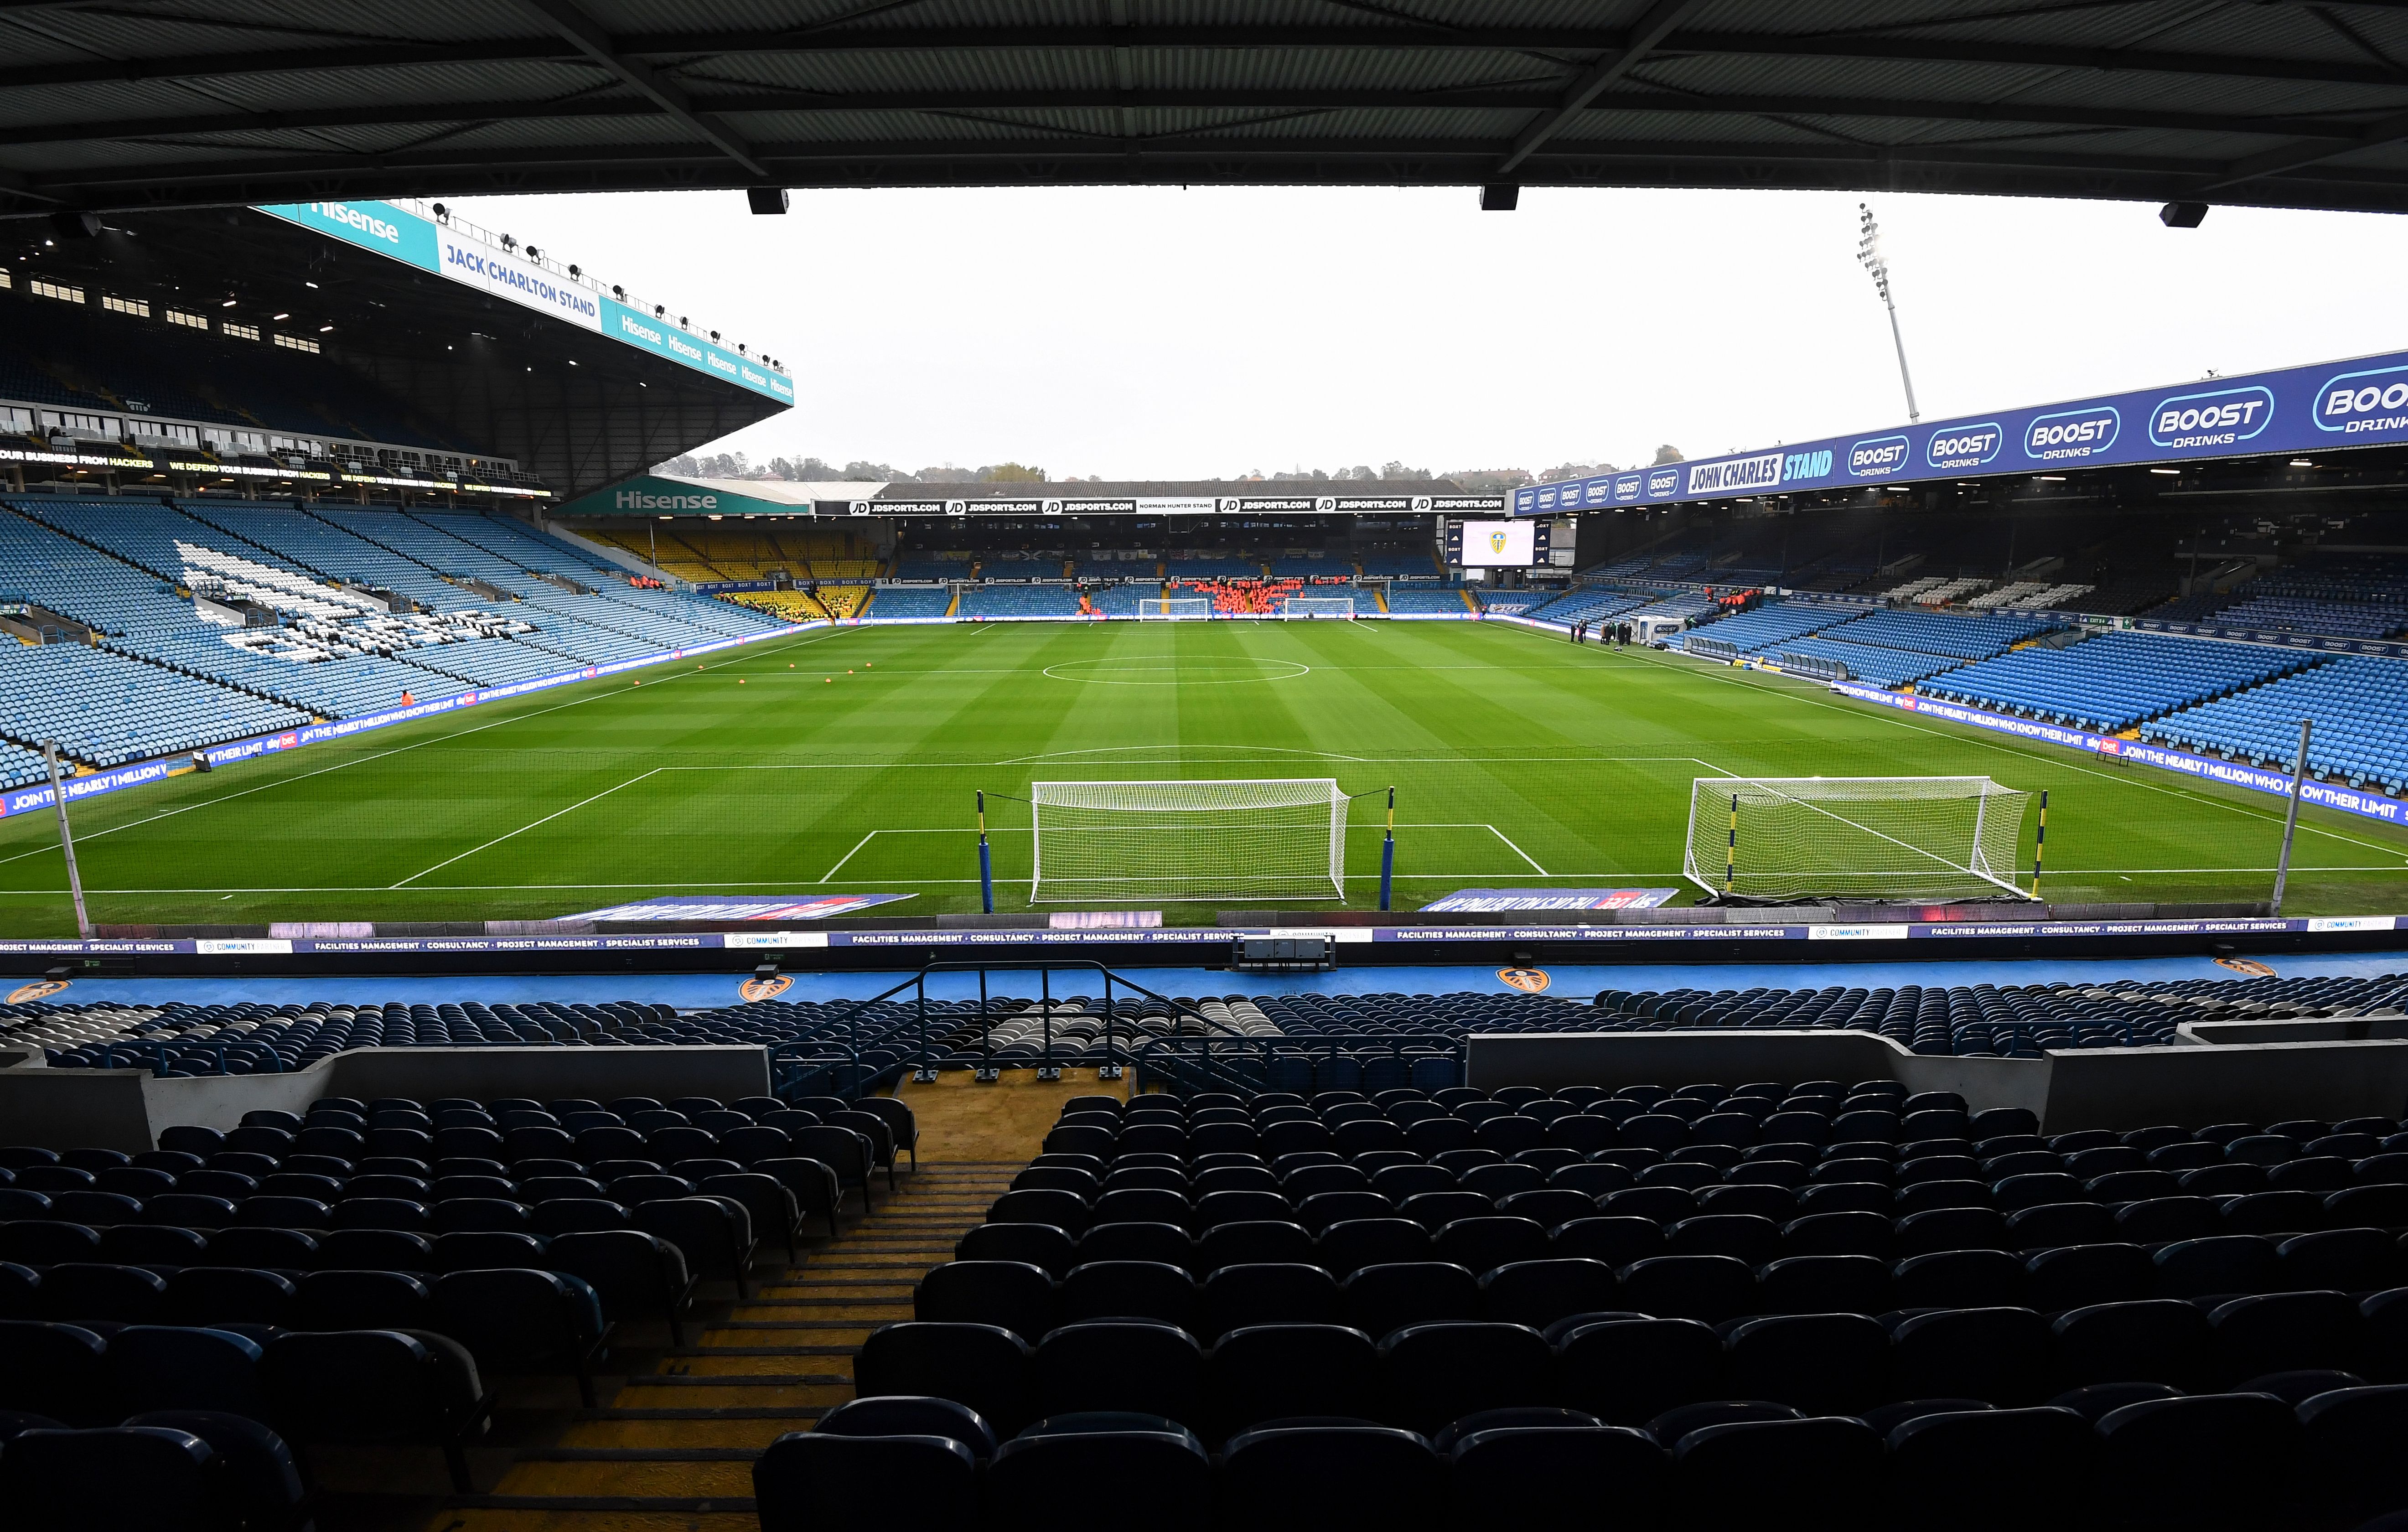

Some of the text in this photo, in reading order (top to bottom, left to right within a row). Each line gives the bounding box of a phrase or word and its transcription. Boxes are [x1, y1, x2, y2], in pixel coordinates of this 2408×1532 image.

[447, 244, 596, 317] JACK CHARLTON STAND
[622, 315, 662, 345] Hisense
[668, 334, 702, 361] Hisense
[707, 351, 737, 375] Hisense
[741, 365, 766, 387] Hisense
[770, 378, 792, 398] Hisense
[2325, 383, 2408, 415] BOO
[2158, 401, 2263, 433] BOOST
[2032, 419, 2112, 446] BOOST
[2172, 433, 2235, 448] DRINKS
[1932, 434, 1996, 456] BOOST
[2043, 447, 2091, 460] DRINKS
[0, 450, 154, 468] OUR BUSINESS FROM HACKERS
[1853, 445, 1904, 466] BOOST
[1941, 458, 1979, 469] DRINKS
[169, 462, 331, 480] WE DEFEND YOUR BUSINESS FROM HACKERS
[1691, 450, 1833, 490] JOHN CHARLES STAND
[1860, 466, 1891, 477] DRINKS
[1588, 485, 1607, 497] BOOST
[1616, 481, 1639, 493] BOOST
[1650, 476, 1676, 489] BOOST
[616, 491, 717, 509] Hisense
[1562, 489, 1579, 500] BOOST
[871, 504, 940, 512] JDSPORTS.COM
[968, 504, 1037, 512] JDSPORTS.COM
[1064, 502, 1133, 511] JDSPORTS.COM
[1242, 501, 1310, 509] JDSPORTS.COM
[1338, 500, 1406, 509] JDSPORTS.COM
[1434, 500, 1502, 508] JDSPORTS.COM
[1895, 696, 1914, 708] sky bet
[314, 694, 475, 738] THE NEARLY MILLION WHO KNOW THEIR LIMIT sky bet
[1917, 701, 2118, 752] JOIN THE NEARLY MILLION WHO KNOW THEIR LIMIT sky bet
[216, 735, 295, 761] THEIR LIMIT sky bet
[13, 792, 43, 810] JOIN
[43, 786, 67, 803] TE
[68, 778, 109, 797] NEARLY
[112, 776, 118, 787] 1
[118, 767, 158, 785] MILLION
[2123, 745, 2398, 818] JOIN THE NEARLY 1 MILLION WHO KOW THEIR LIMIT
[2326, 921, 2362, 929] COMMUNITY
[427, 941, 489, 949] CONSULTANCY
[746, 937, 788, 945] COMMUNITY
